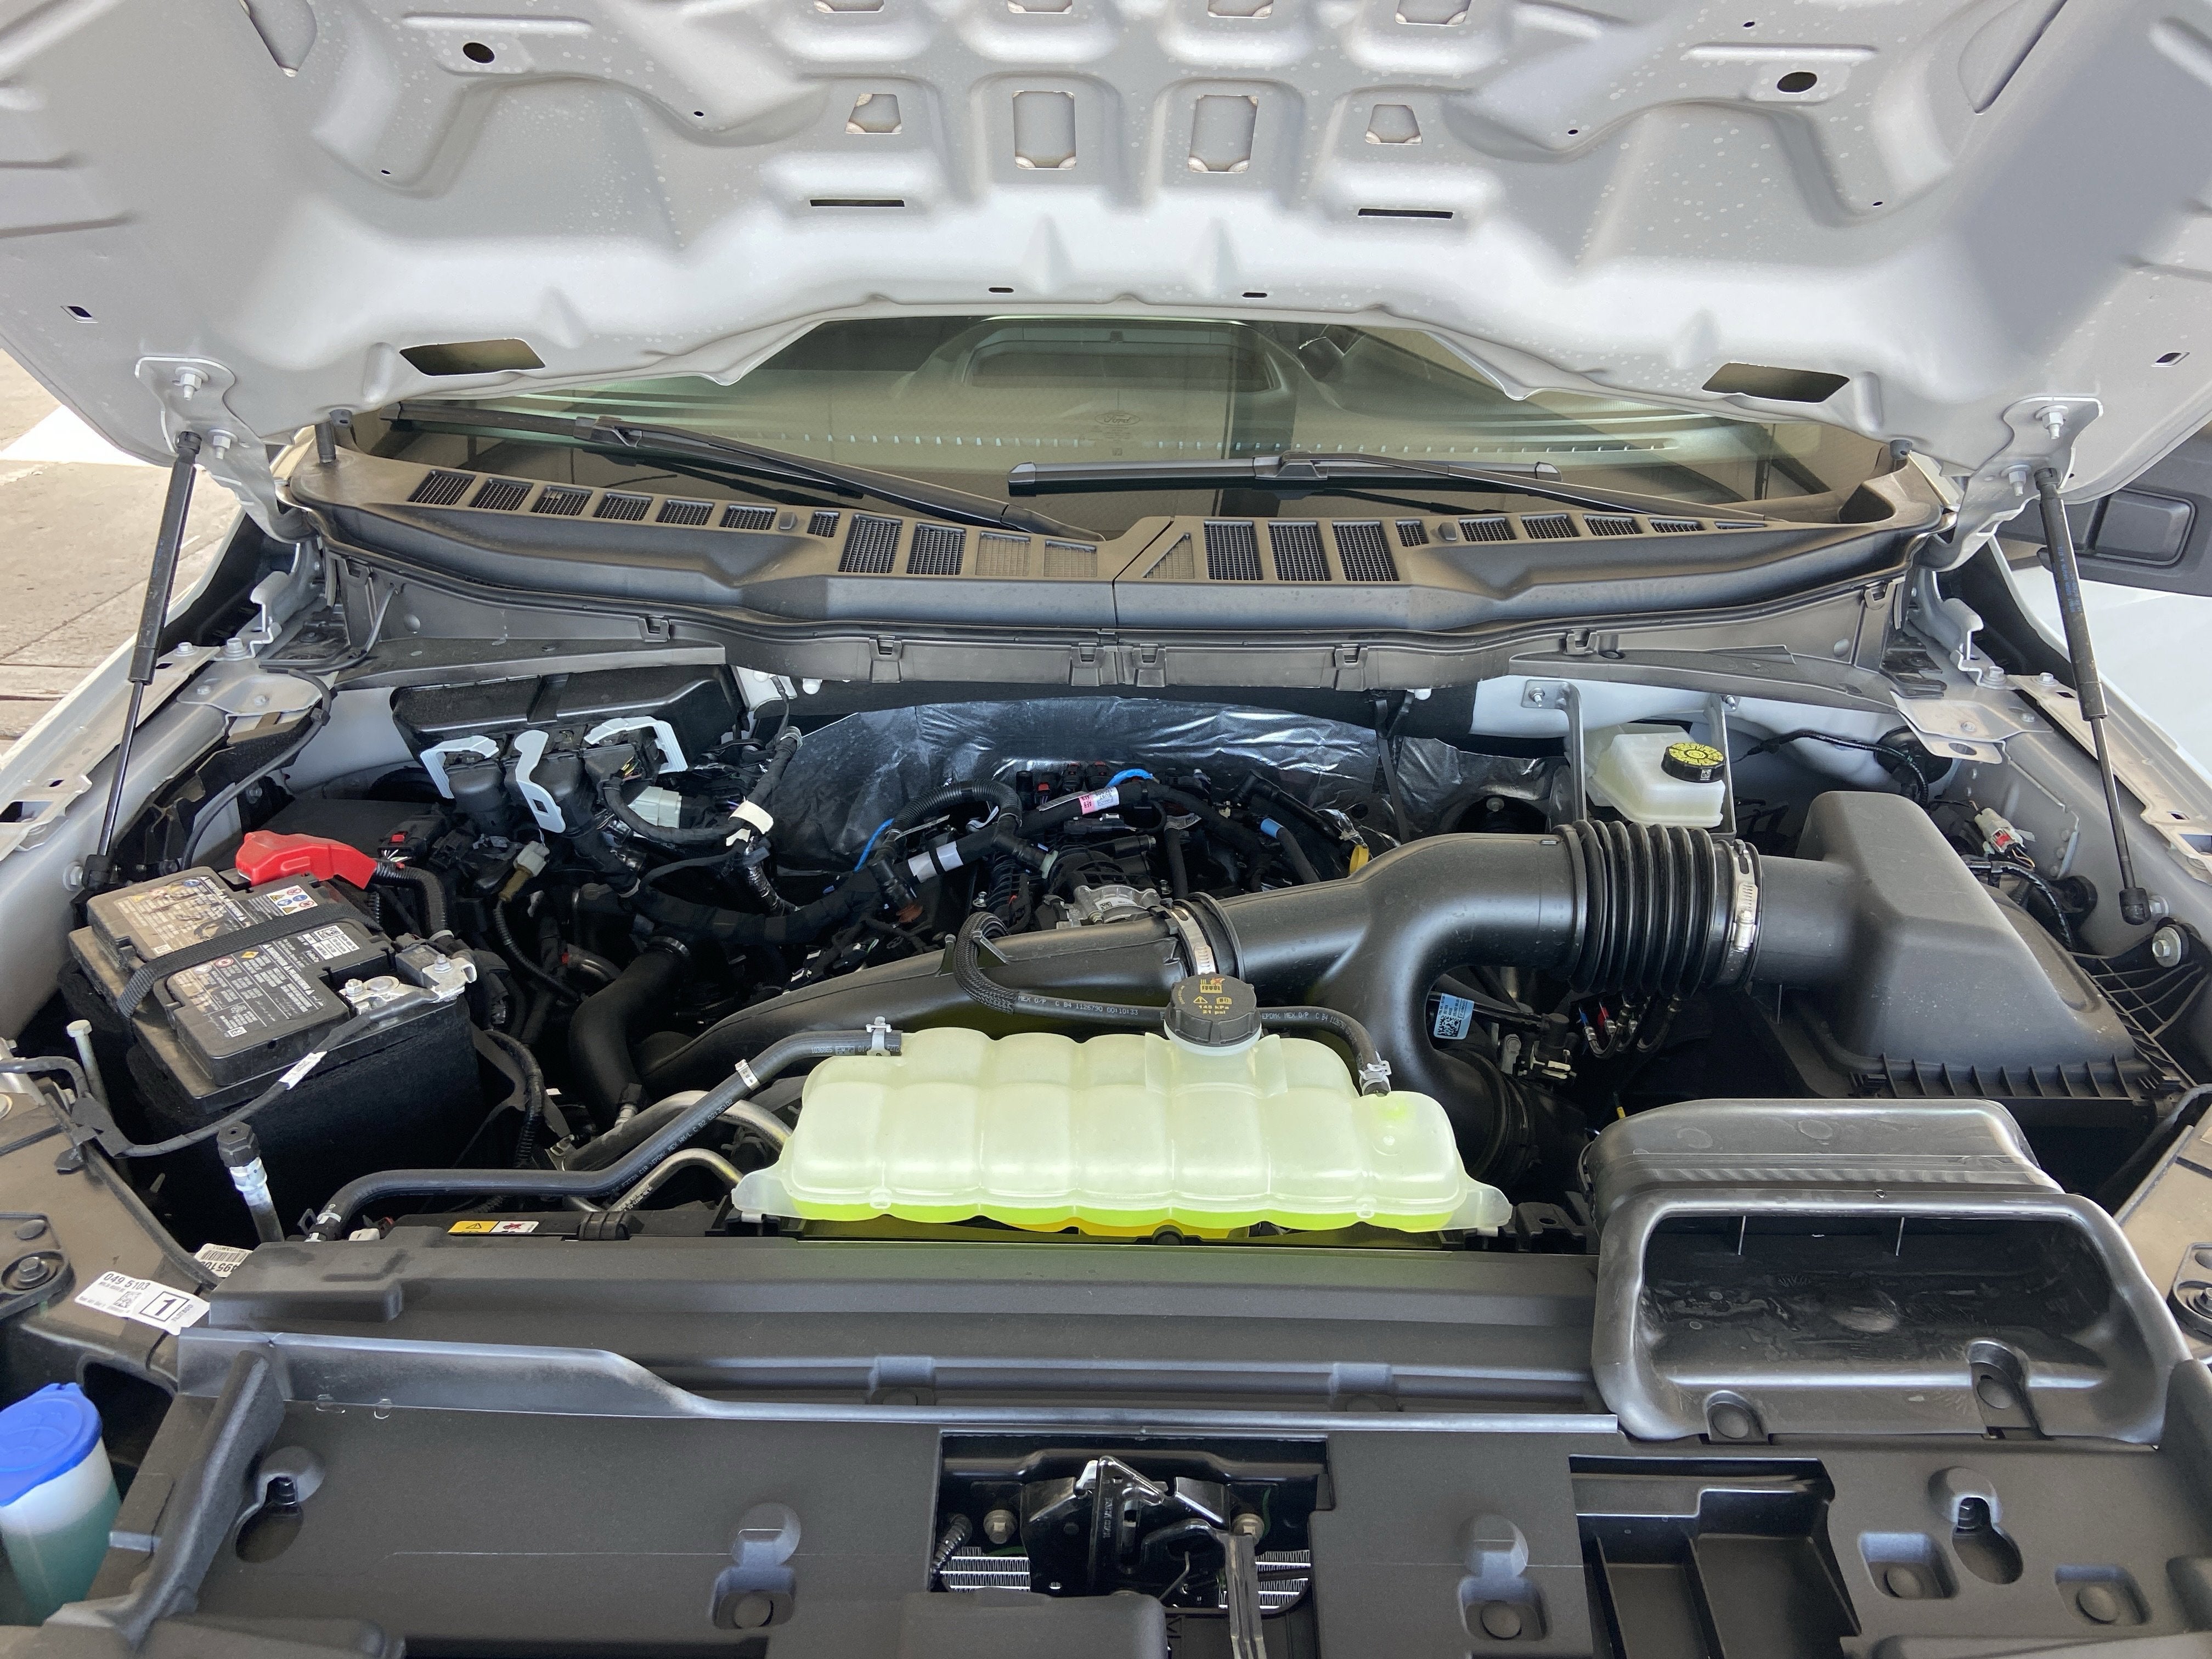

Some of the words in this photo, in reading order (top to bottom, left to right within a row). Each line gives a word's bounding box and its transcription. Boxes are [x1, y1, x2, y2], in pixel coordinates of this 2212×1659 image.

[1104, 414, 1131, 424] Ford
[1076, 1003, 1103, 1012] 1126790
[667, 1142, 679, 1152] MEX
[698, 1120, 707, 1128] B2
[103, 1273, 125, 1285] 049
[125, 1280, 151, 1290] 5103
[154, 1298, 177, 1316] 1
